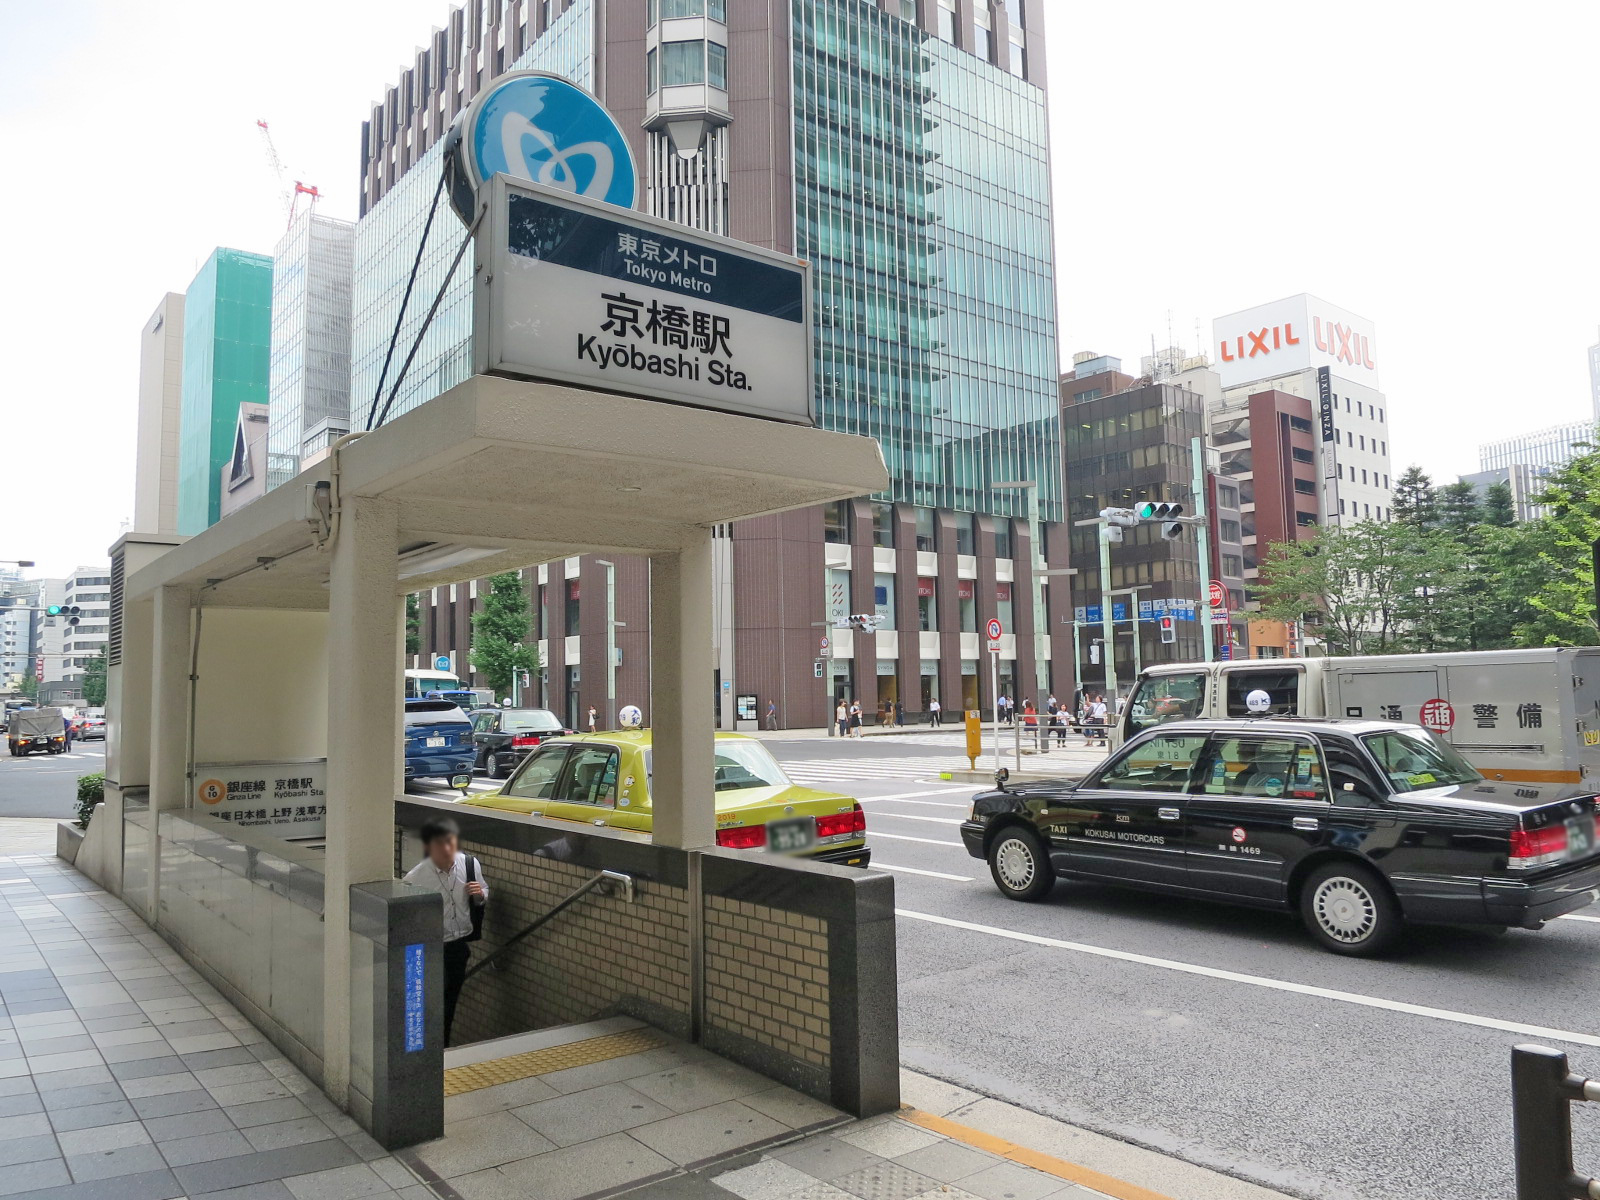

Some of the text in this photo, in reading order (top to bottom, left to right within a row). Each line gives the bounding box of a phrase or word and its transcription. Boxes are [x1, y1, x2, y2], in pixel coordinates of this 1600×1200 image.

[617, 232, 717, 277] 東京メトロ
[624, 259, 711, 294] Tokyo Metro
[600, 292, 733, 359] 京橋駅
[1221, 323, 1300, 362] LIXIL
[1313, 315, 1374, 370] LIXIL
[577, 333, 752, 392] Kyōbashi Sta.
[631, 709, 640, 725] 大和
[1473, 703, 1542, 728] 警備
[1150, 738, 1185, 748] NITTSU
[227, 778, 313, 793] 銀座線 京橋駅
[234, 808, 267, 820] 日本橋
[270, 807, 292, 818] 上野
[717, 813, 736, 821] 2019
[1050, 824, 1067, 834] TAXI
[1085, 828, 1165, 845] KOKUSAI MOTORCARS
[1240, 846, 1261, 855] 1469
